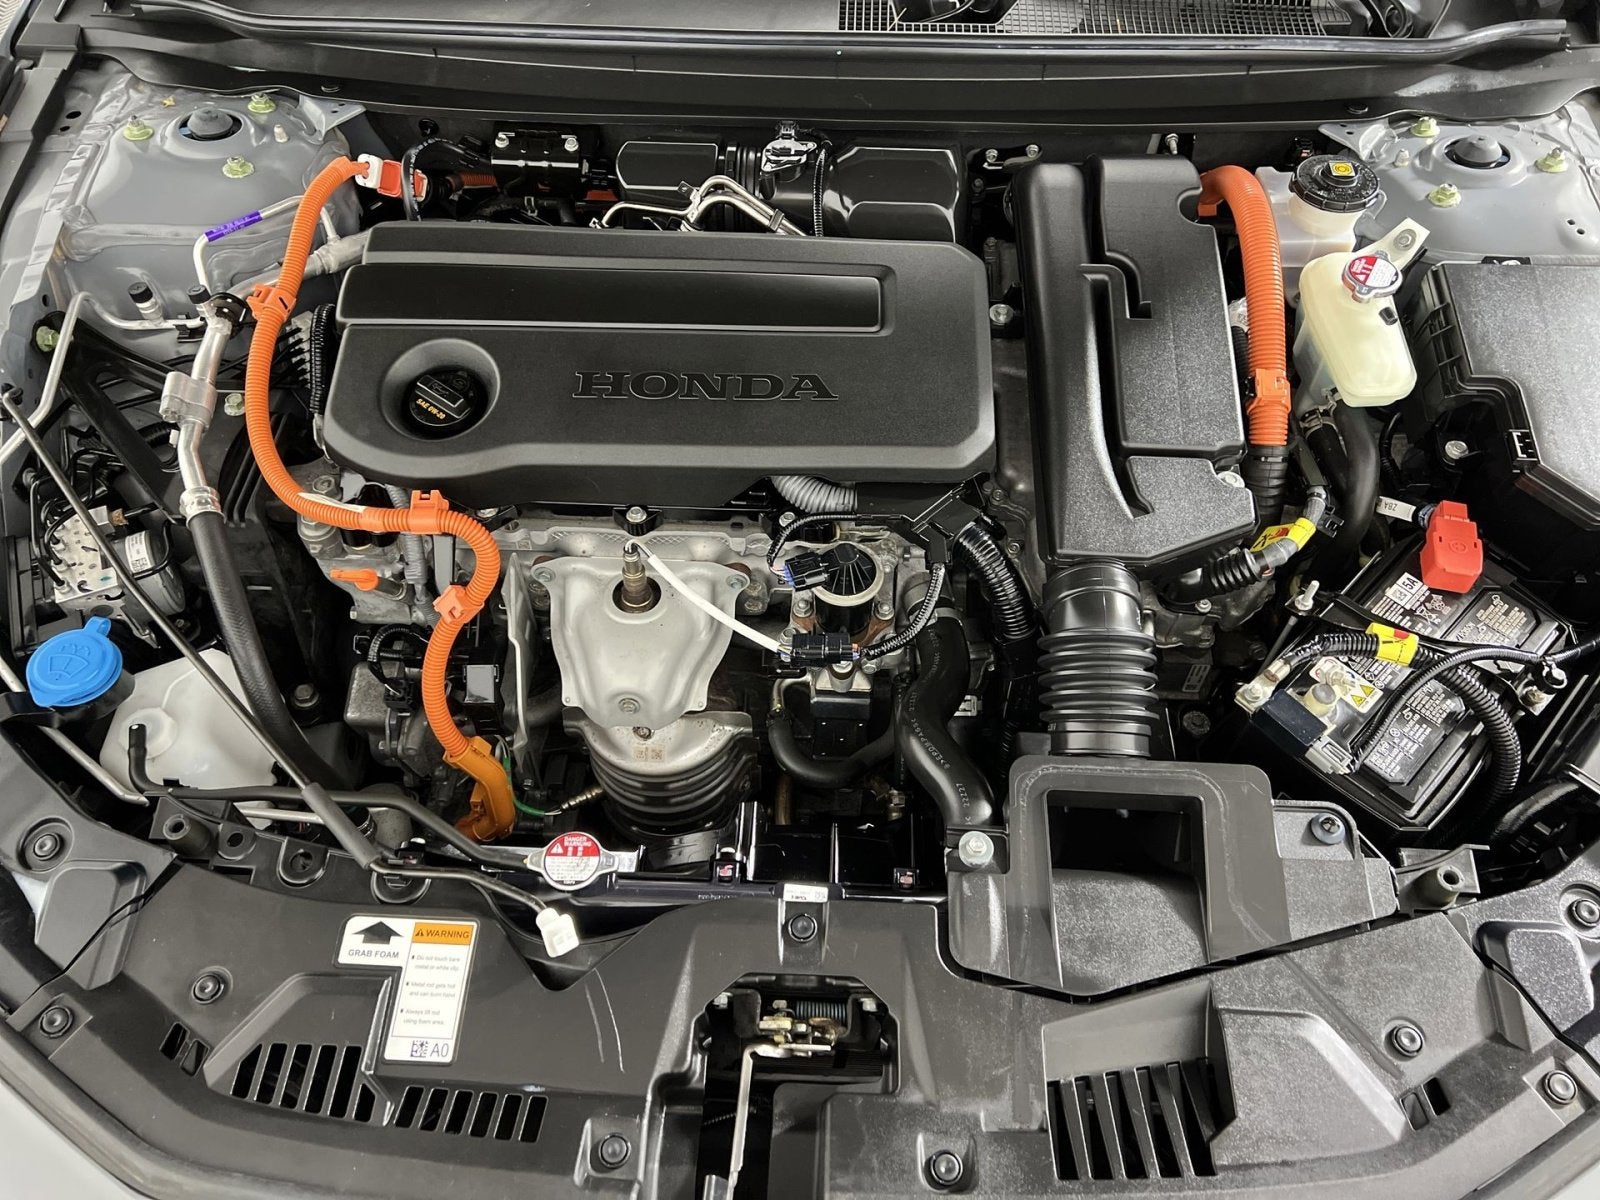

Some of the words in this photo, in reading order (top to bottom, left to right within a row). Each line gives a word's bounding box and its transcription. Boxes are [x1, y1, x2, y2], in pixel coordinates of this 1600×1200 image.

[572, 370, 839, 401] HONDA
[416, 398, 430, 408] SAE
[427, 406, 446, 419] 0W-20
[1402, 577, 1418, 590] 5A
[426, 930, 470, 939] WARNING
[348, 949, 372, 958] GRAB
[374, 950, 400, 958] FOAM
[430, 1043, 449, 1058] A0
